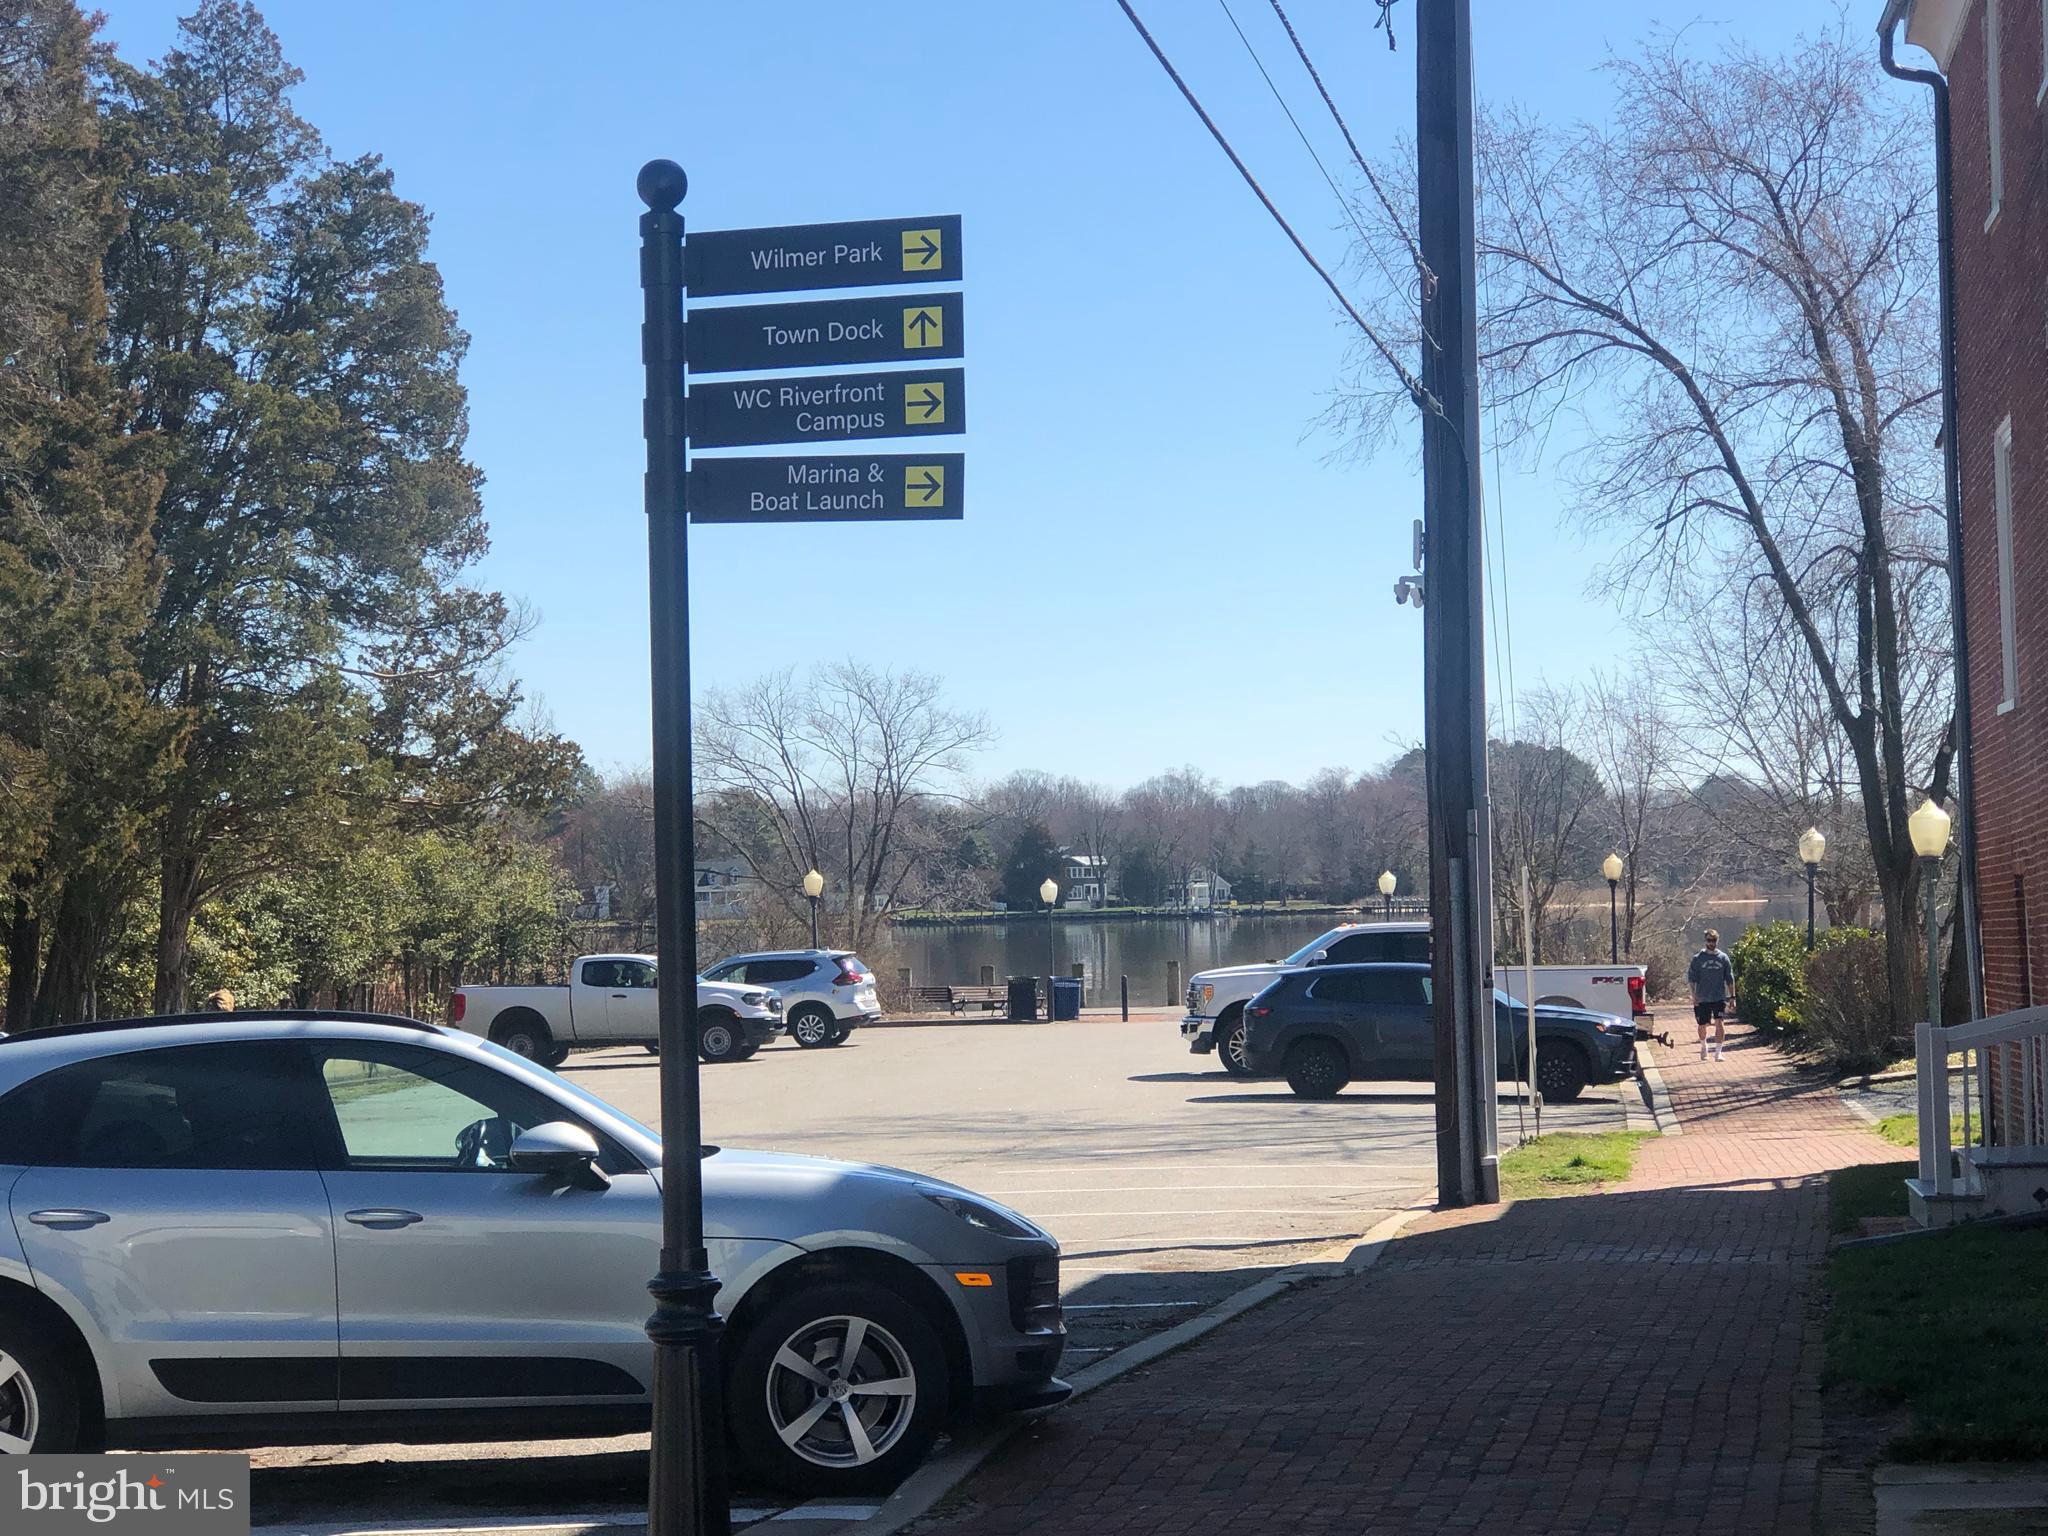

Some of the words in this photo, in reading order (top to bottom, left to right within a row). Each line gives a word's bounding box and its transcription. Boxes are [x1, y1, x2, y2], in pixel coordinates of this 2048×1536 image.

[751, 248, 826, 270] Wilmer
[834, 242, 883, 264] Park
[763, 325, 819, 345] Town
[828, 319, 883, 341] Dock
[733, 389, 772, 409] WC
[780, 382, 884, 406] Riverfront
[796, 411, 885, 434] Campus
[788, 464, 860, 484] Marina
[867, 463, 884, 482] &
[750, 492, 798, 512] Boat
[806, 489, 884, 510] Launch
[1592, 976, 1624, 985] FX4
